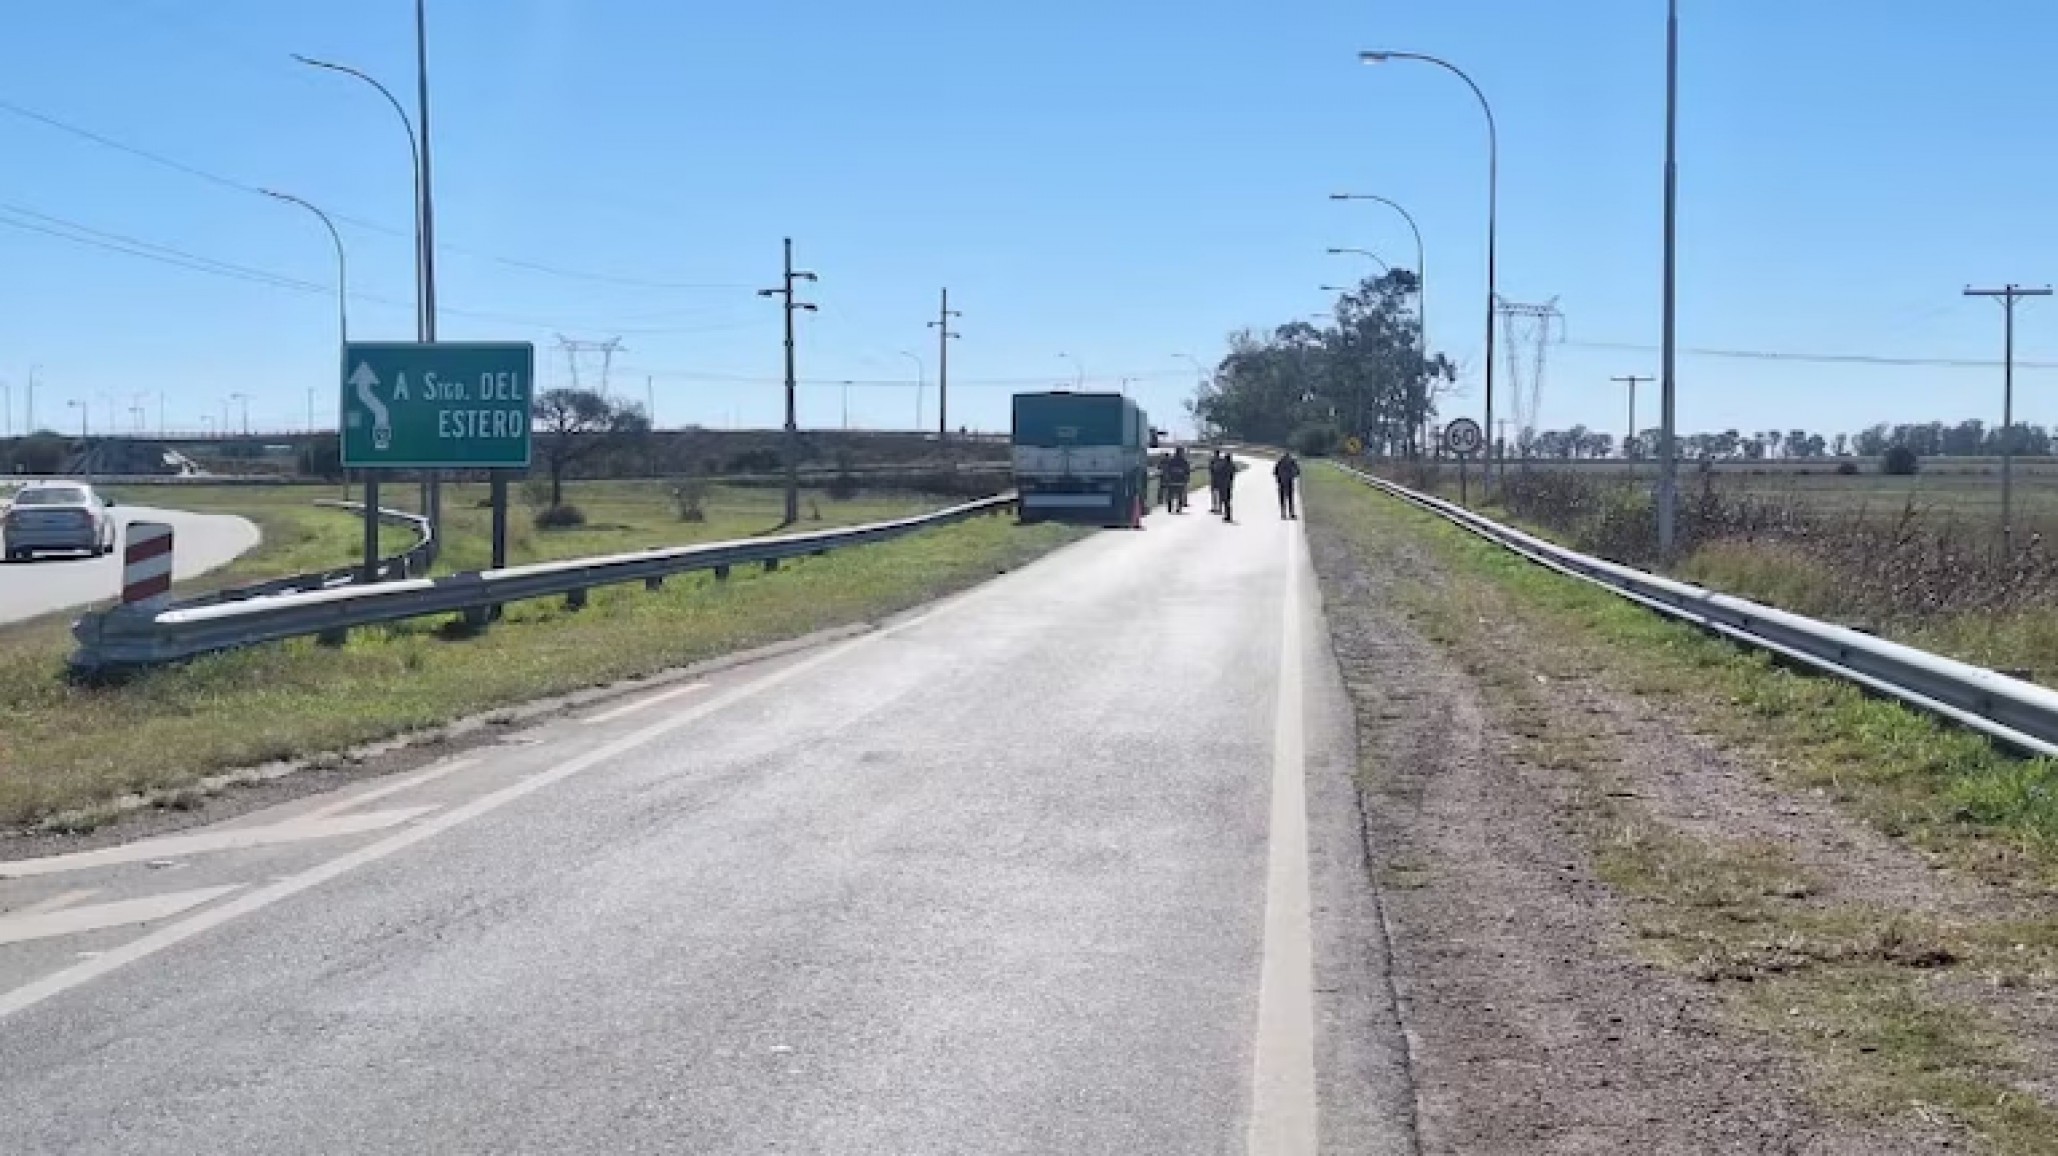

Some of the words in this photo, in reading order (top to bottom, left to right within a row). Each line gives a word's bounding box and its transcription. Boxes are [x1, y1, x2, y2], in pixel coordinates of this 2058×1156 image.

[393, 371, 411, 400] A
[480, 371, 524, 400] DEL
[438, 409, 524, 438] ESTERO
[1452, 429, 1475, 447] 60
